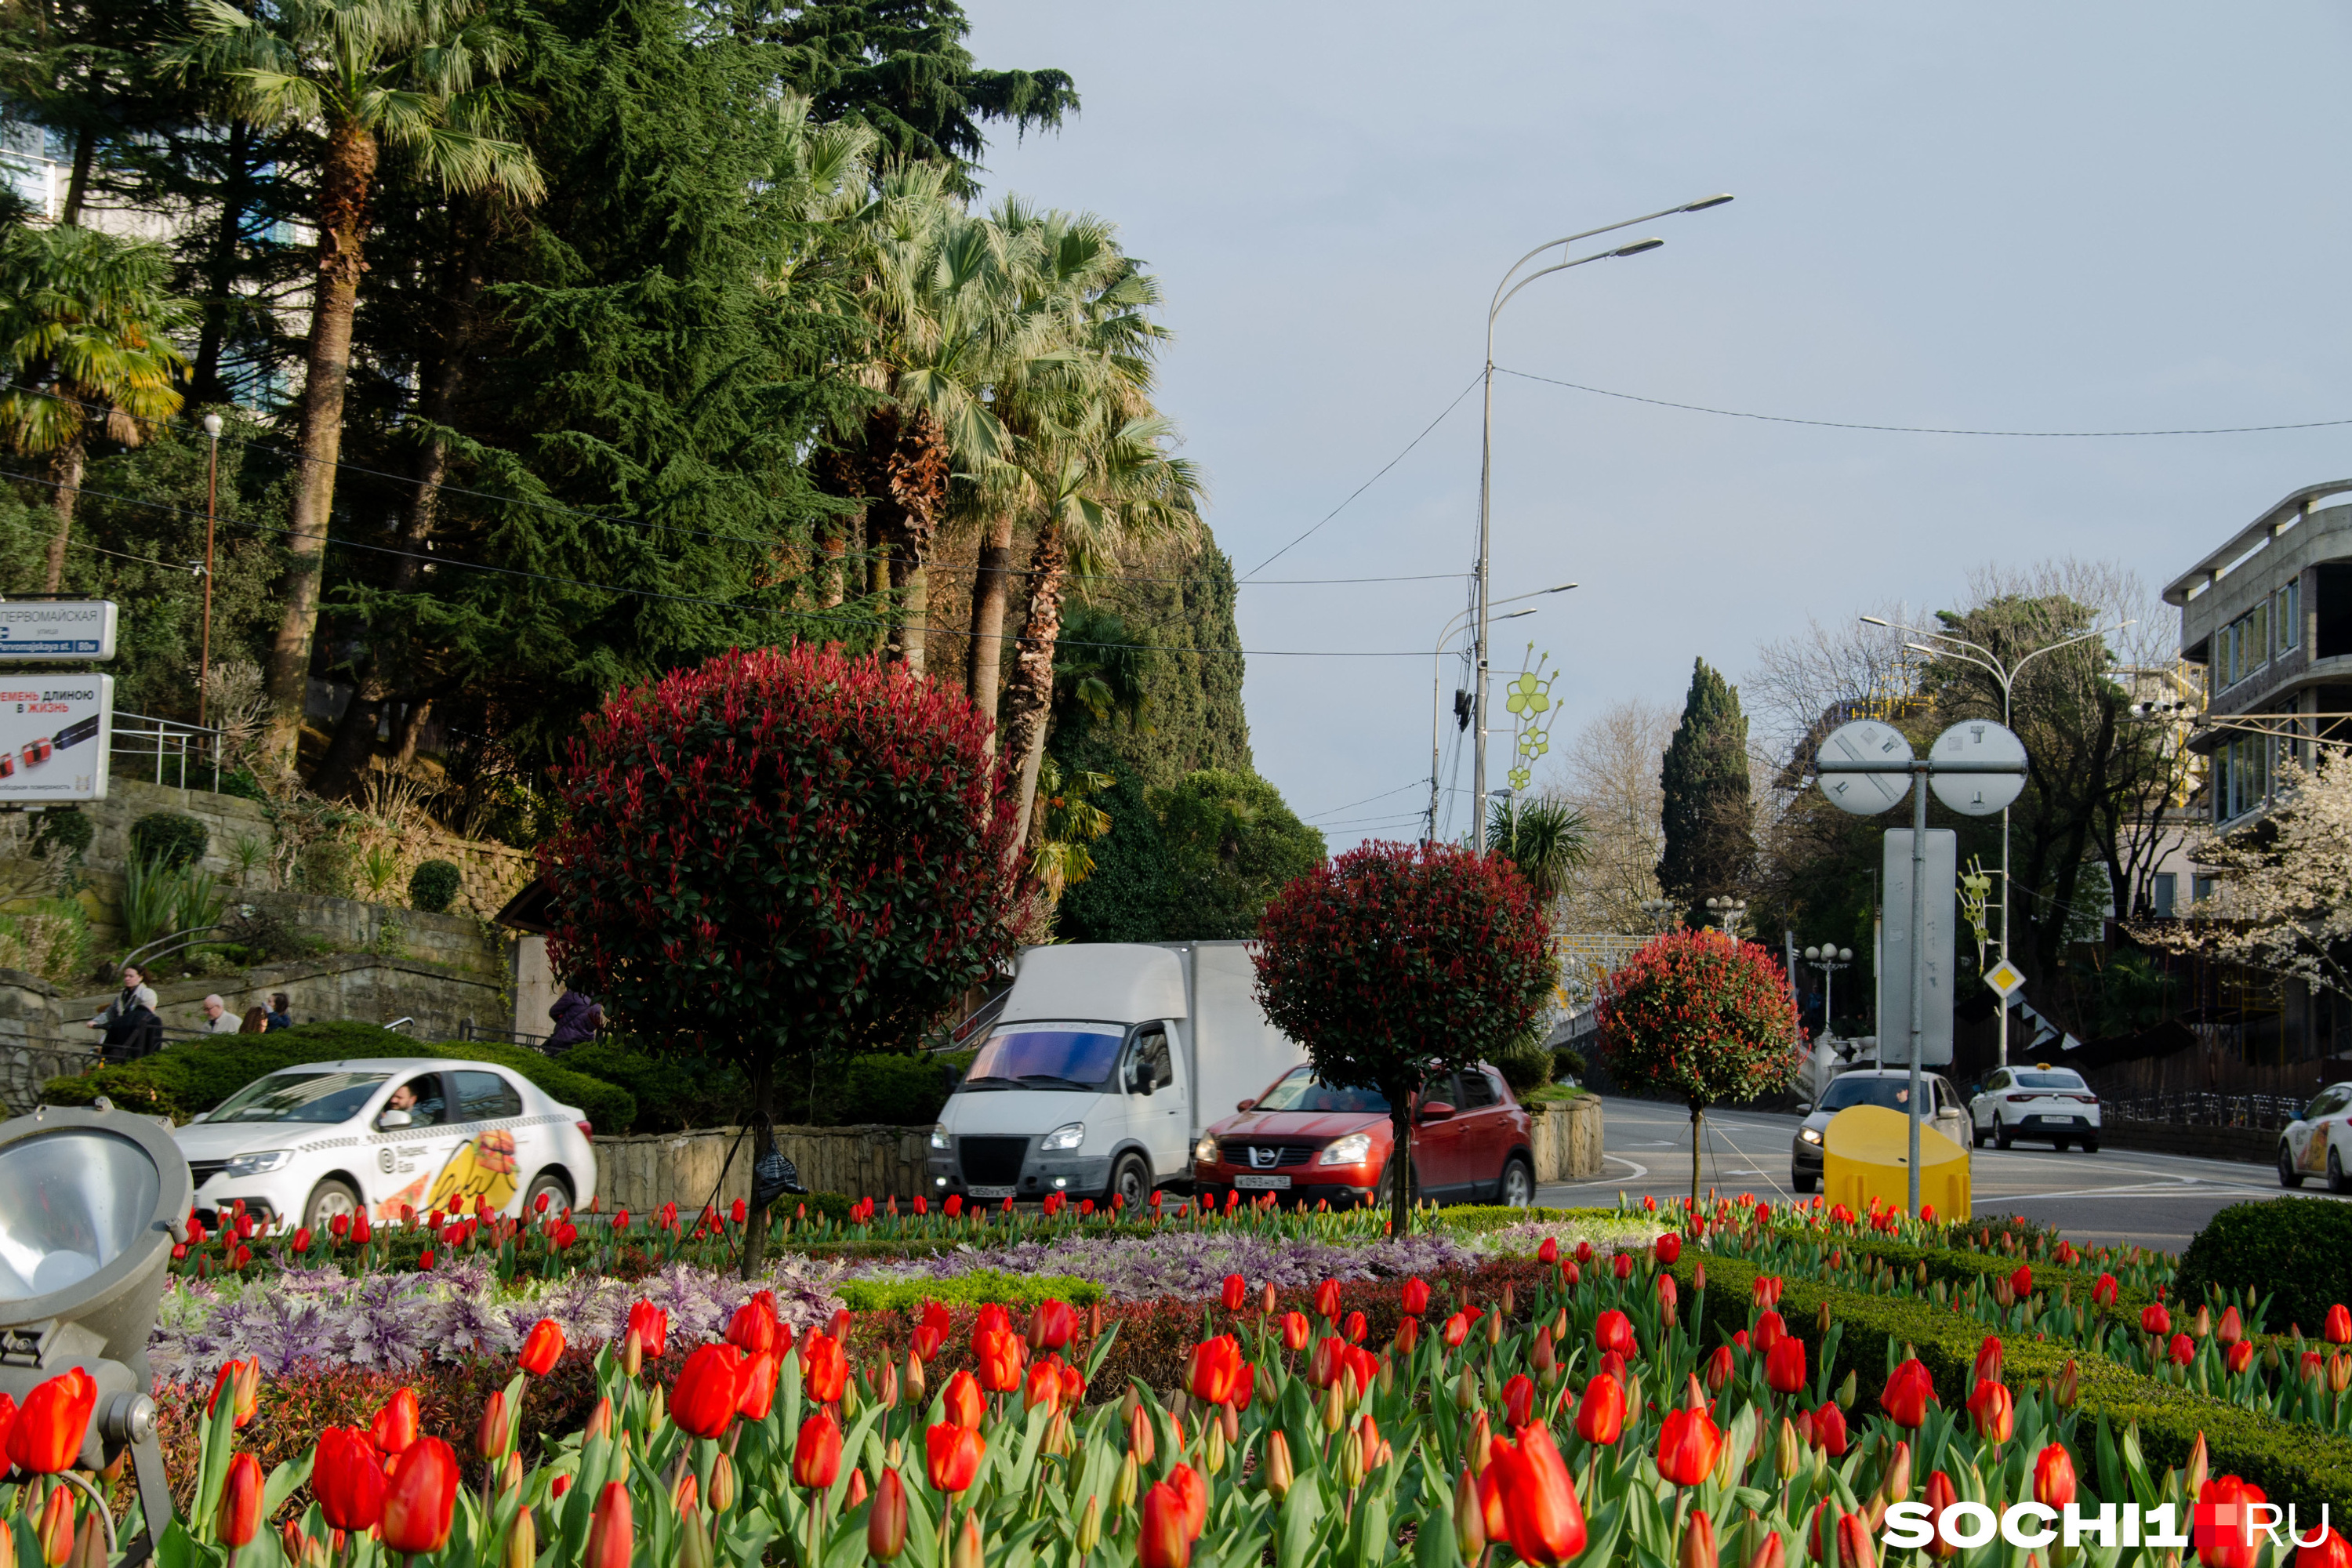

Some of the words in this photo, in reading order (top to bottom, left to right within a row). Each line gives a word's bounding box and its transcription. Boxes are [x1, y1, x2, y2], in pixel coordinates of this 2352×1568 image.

[0, 608, 97, 622] ПЕРВОМАЙСКАЯ
[0, 691, 40, 702] ЕМЕНЬ
[42, 690, 94, 702] ДЛИНОЮ
[16, 703, 24, 713] В
[27, 702, 69, 713] ЖИЗНЬ
